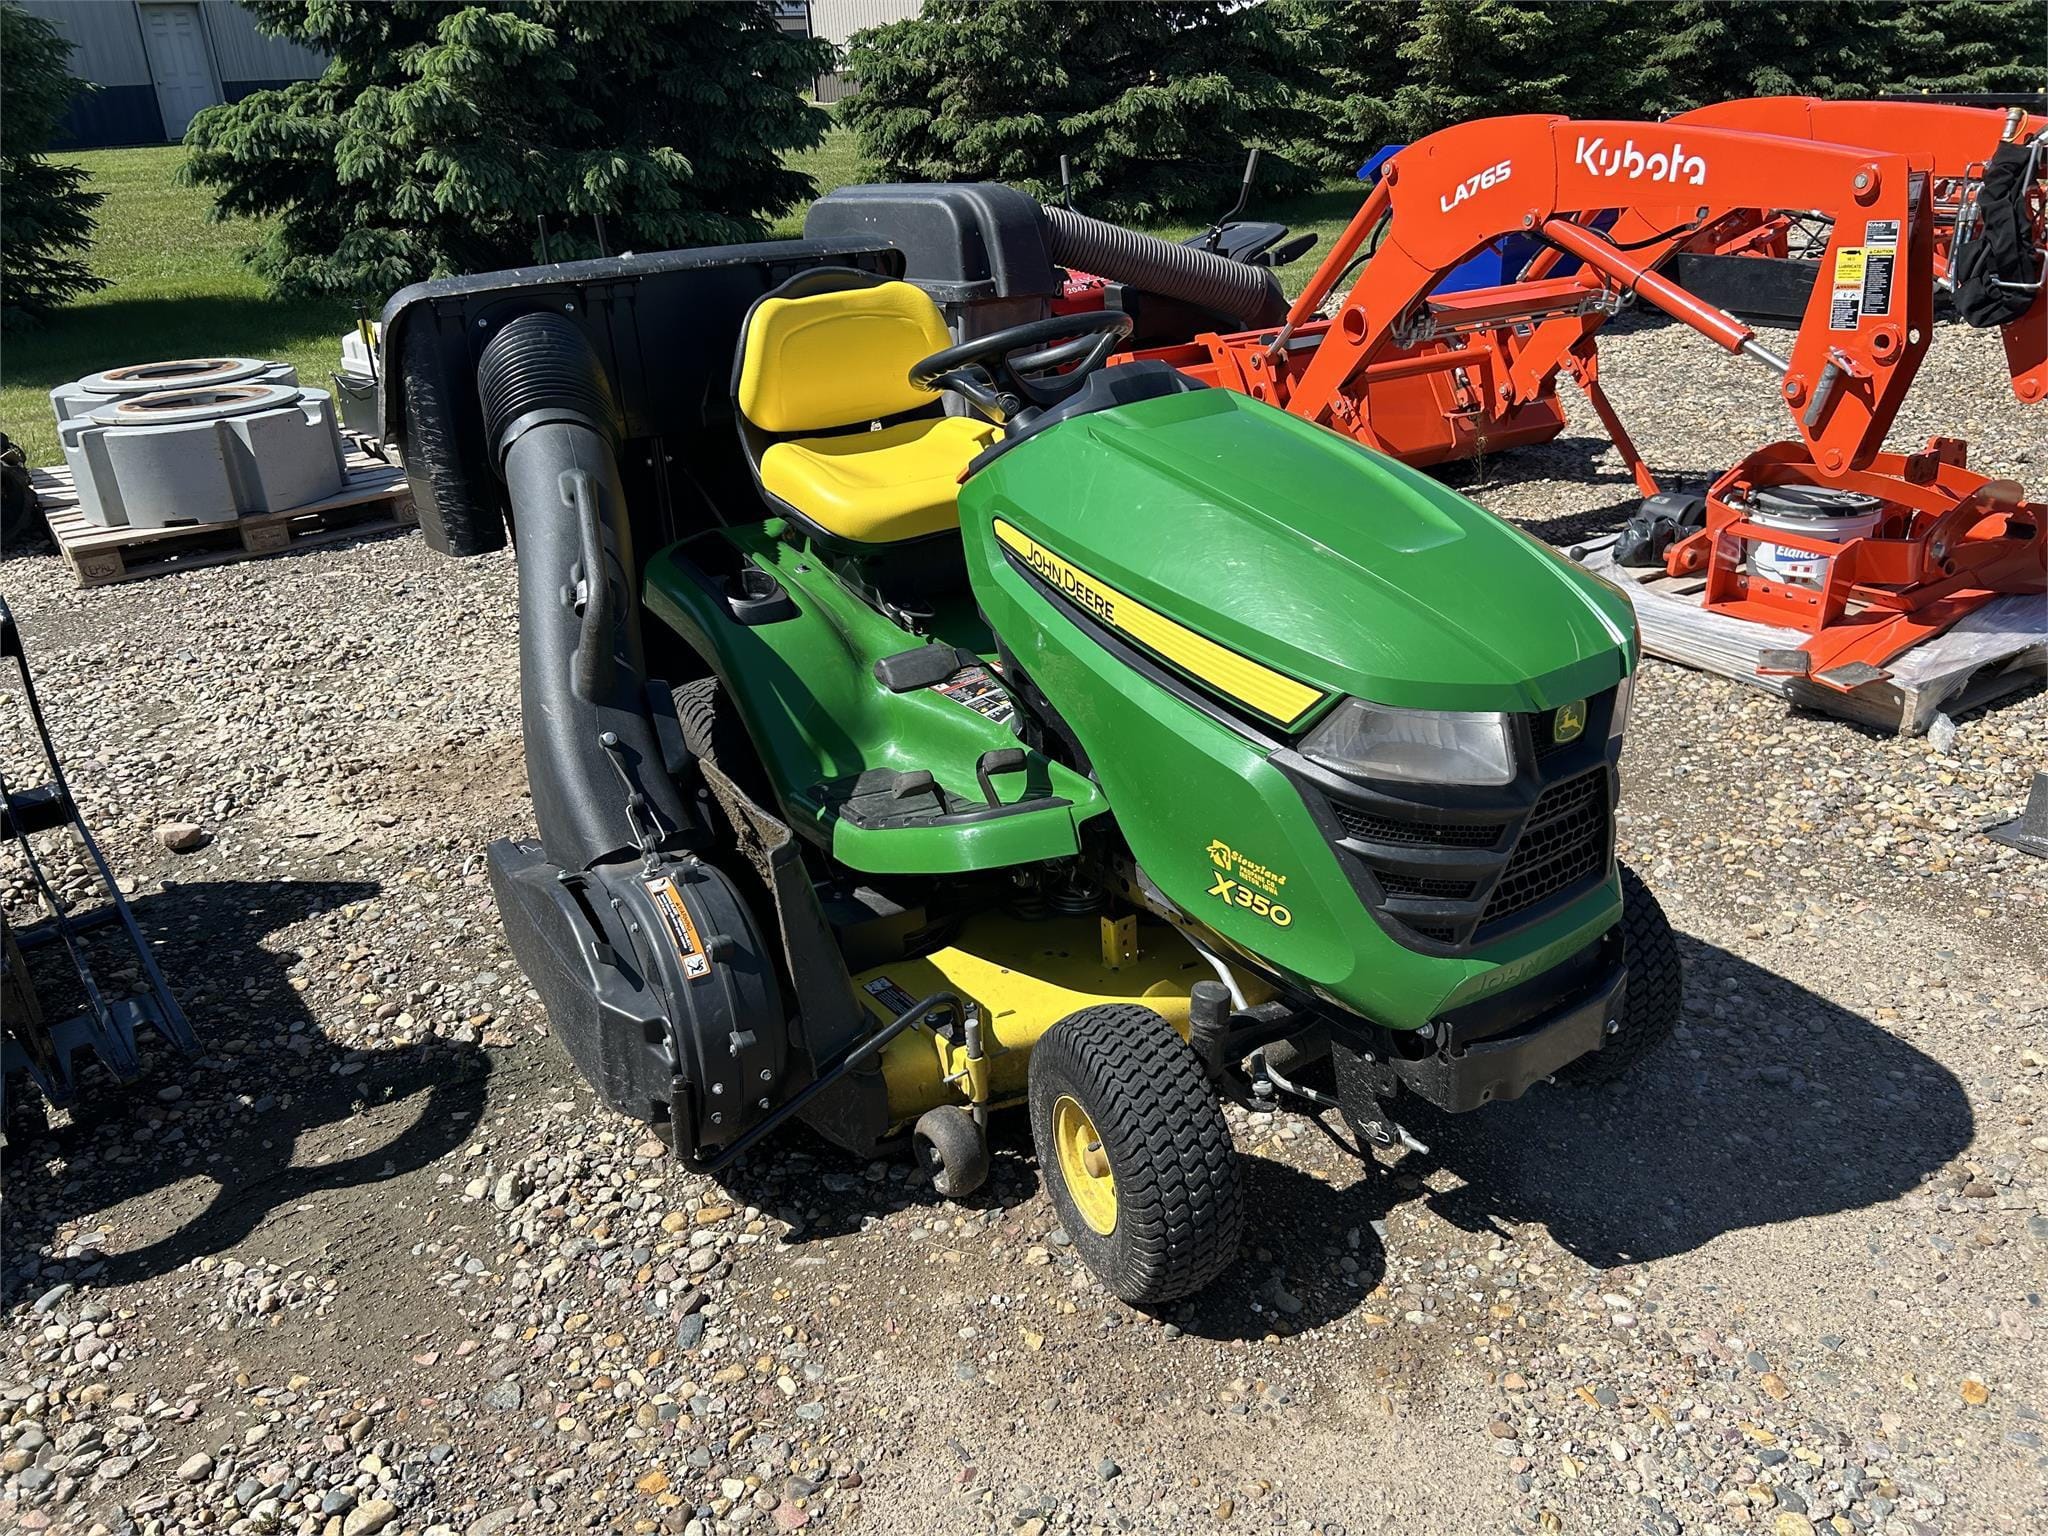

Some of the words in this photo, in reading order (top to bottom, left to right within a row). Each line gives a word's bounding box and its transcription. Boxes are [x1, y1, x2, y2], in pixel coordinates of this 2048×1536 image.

[1439, 159, 1512, 213] LA765
[1575, 136, 1706, 186] Kubota
[1066, 285, 1088, 295] 2042
[1026, 542, 1062, 586] JOHN
[1064, 568, 1115, 622] DEERE
[1231, 850, 1287, 885] Siouxland
[1206, 869, 1294, 927] X350
